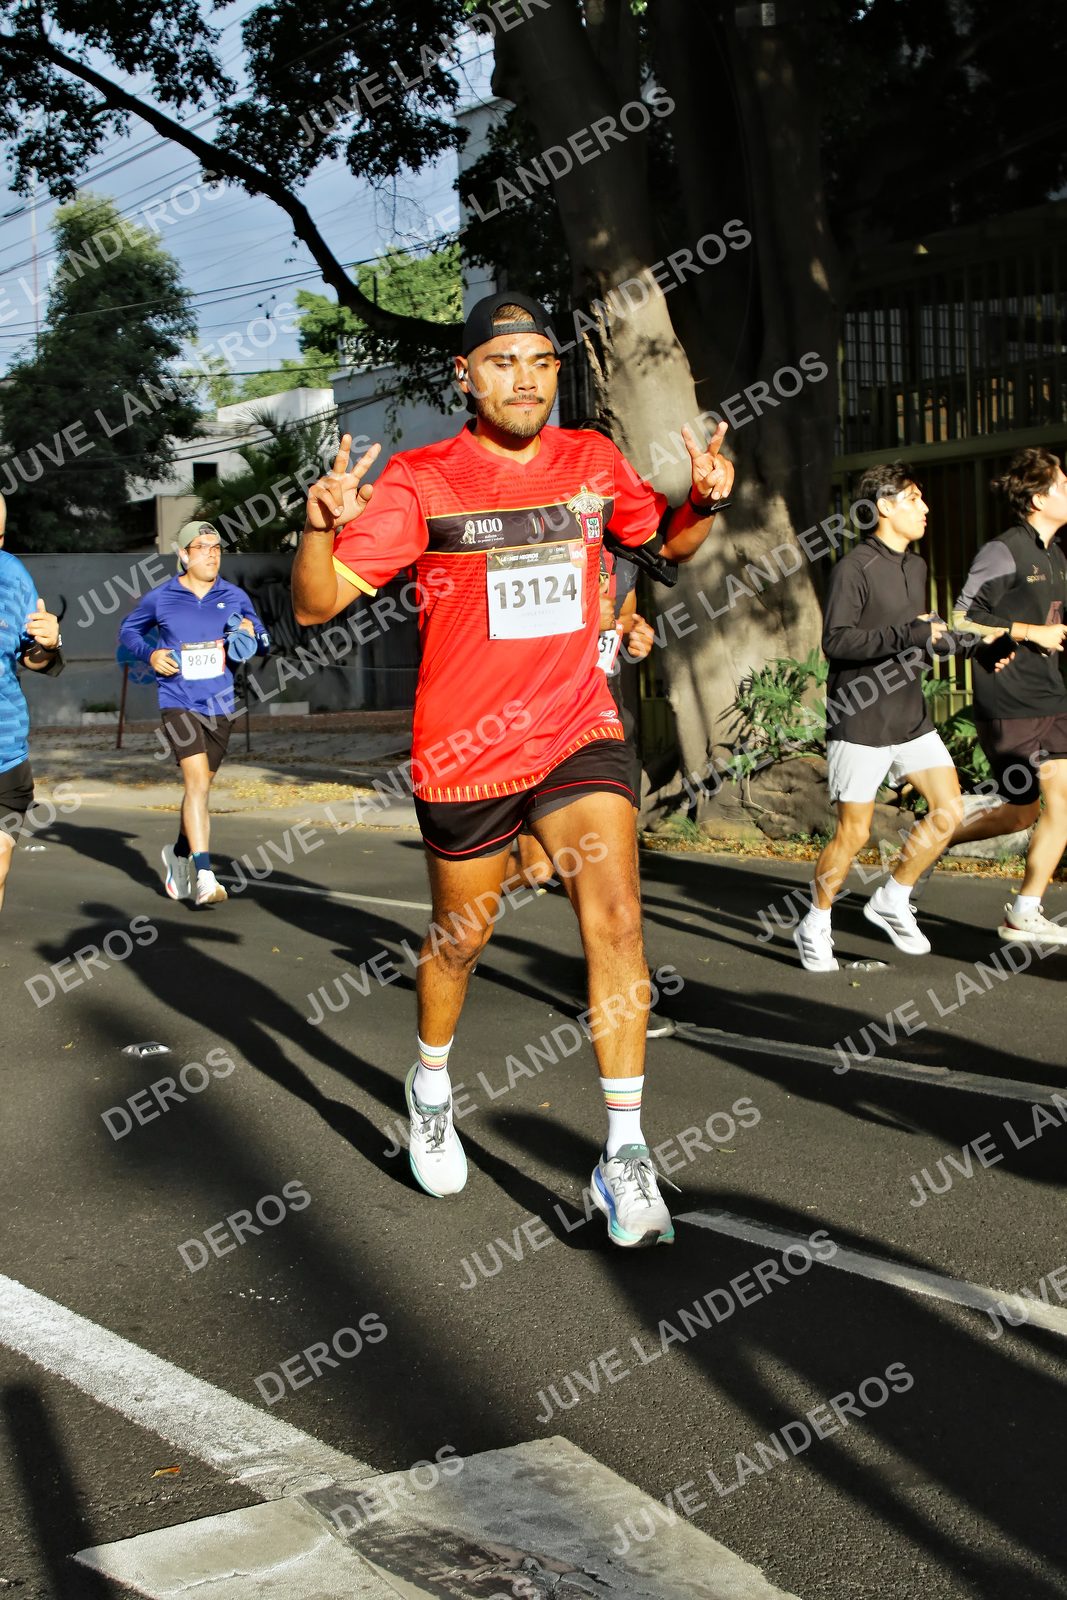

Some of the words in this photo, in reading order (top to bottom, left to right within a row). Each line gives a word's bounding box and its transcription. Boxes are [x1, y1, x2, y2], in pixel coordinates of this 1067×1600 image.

[475, 518, 503, 534] 100
[494, 573, 577, 609] 13124
[188, 653, 217, 667] 9876
